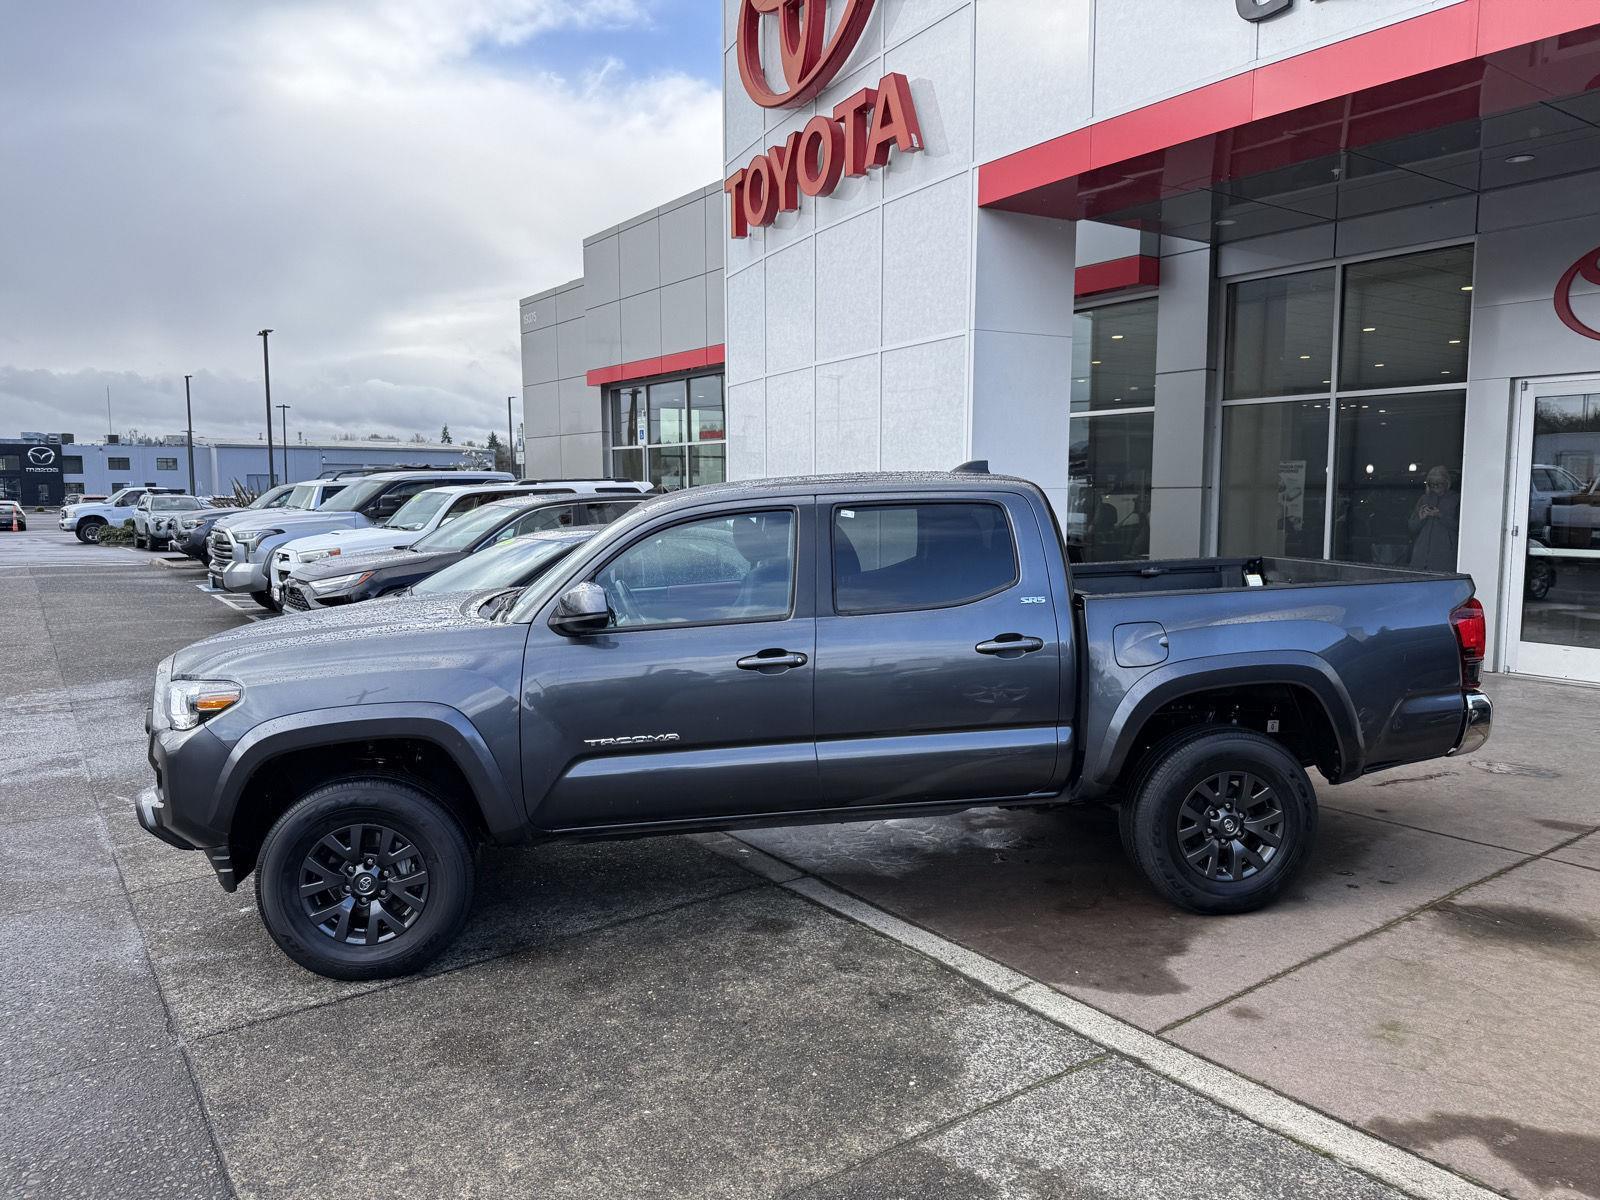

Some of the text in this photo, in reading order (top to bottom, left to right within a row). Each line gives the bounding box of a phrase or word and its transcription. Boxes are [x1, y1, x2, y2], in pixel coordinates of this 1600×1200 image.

[724, 72, 924, 239] TOYOTA
[1020, 596, 1046, 604] SR5
[584, 732, 680, 746] TACOMA
